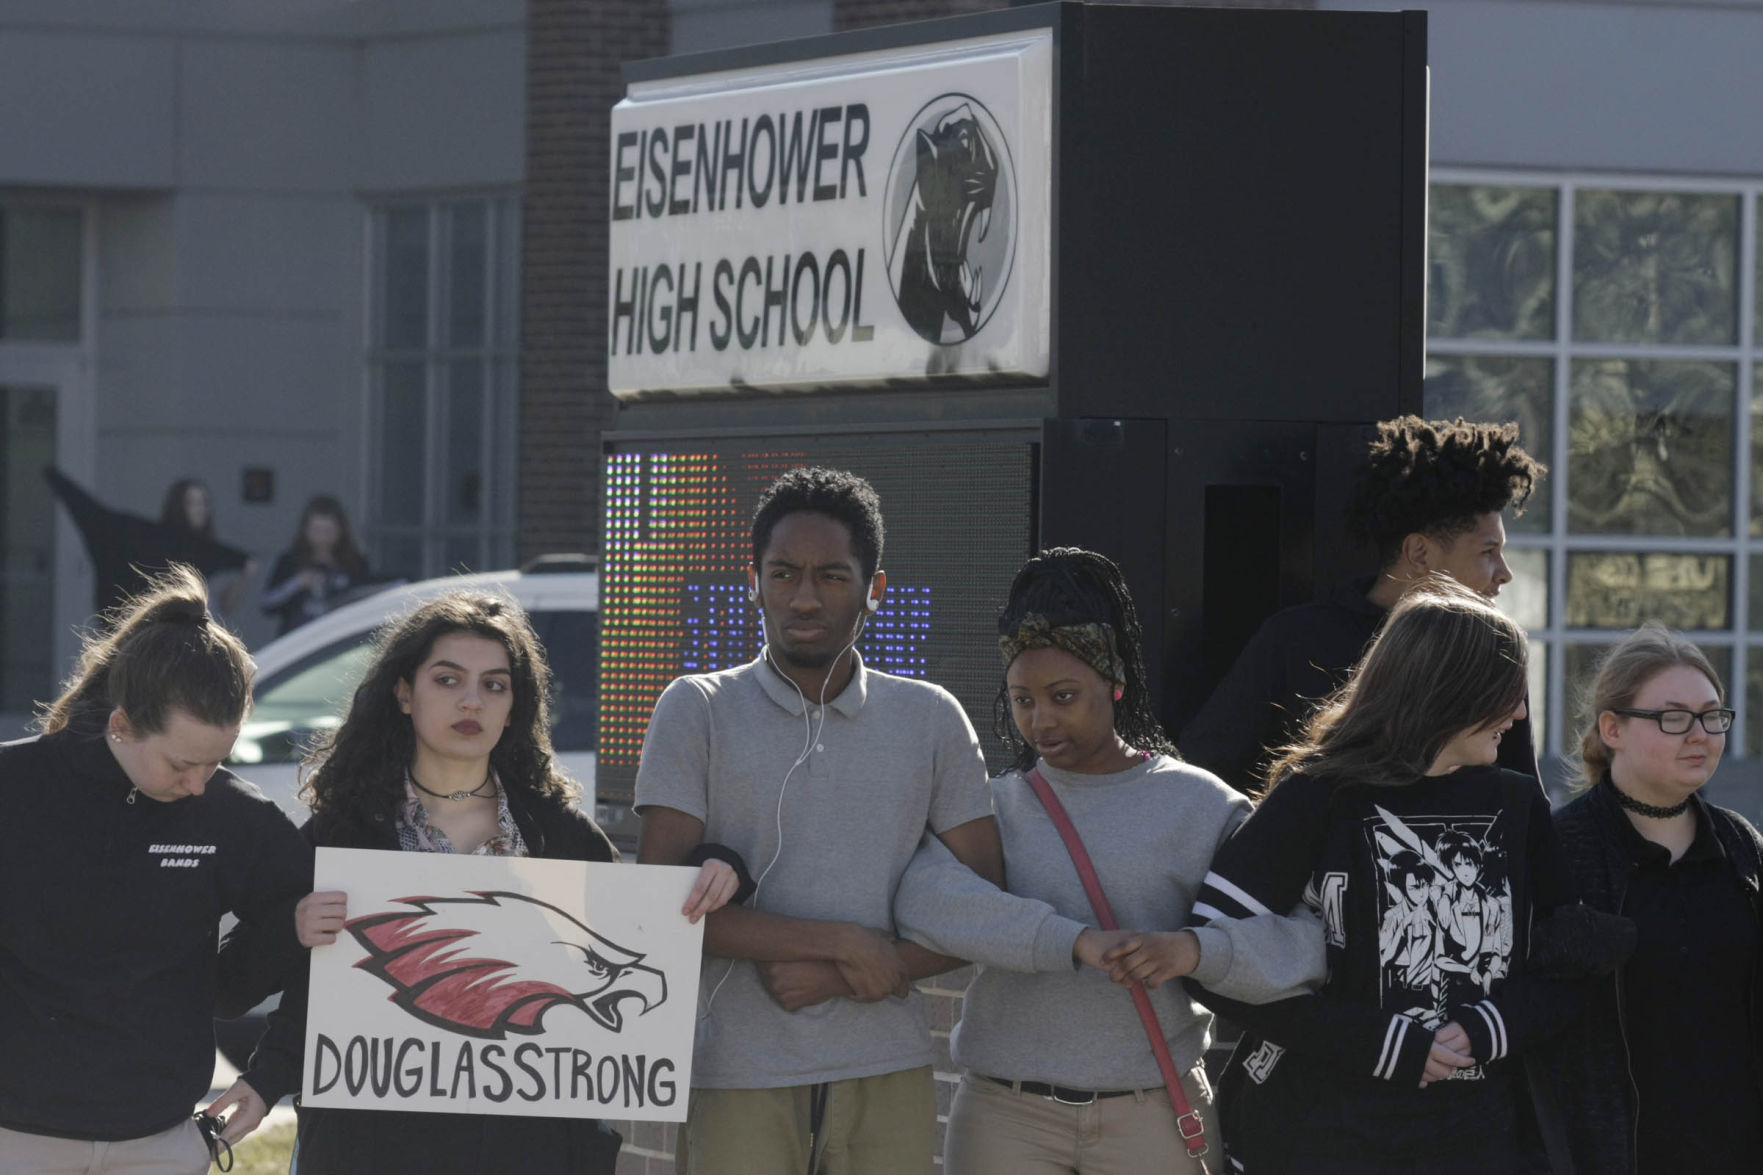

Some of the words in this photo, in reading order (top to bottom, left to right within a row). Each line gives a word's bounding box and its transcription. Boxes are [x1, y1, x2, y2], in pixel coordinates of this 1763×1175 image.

[611, 103, 870, 222] EISENHOWER
[610, 261, 703, 356] HIGH
[709, 248, 875, 352] SCHOOL
[148, 844, 217, 854] EISENHOWER
[160, 858, 200, 868] BANDS
[312, 1033, 677, 1109] DOUGLASSTRONG
